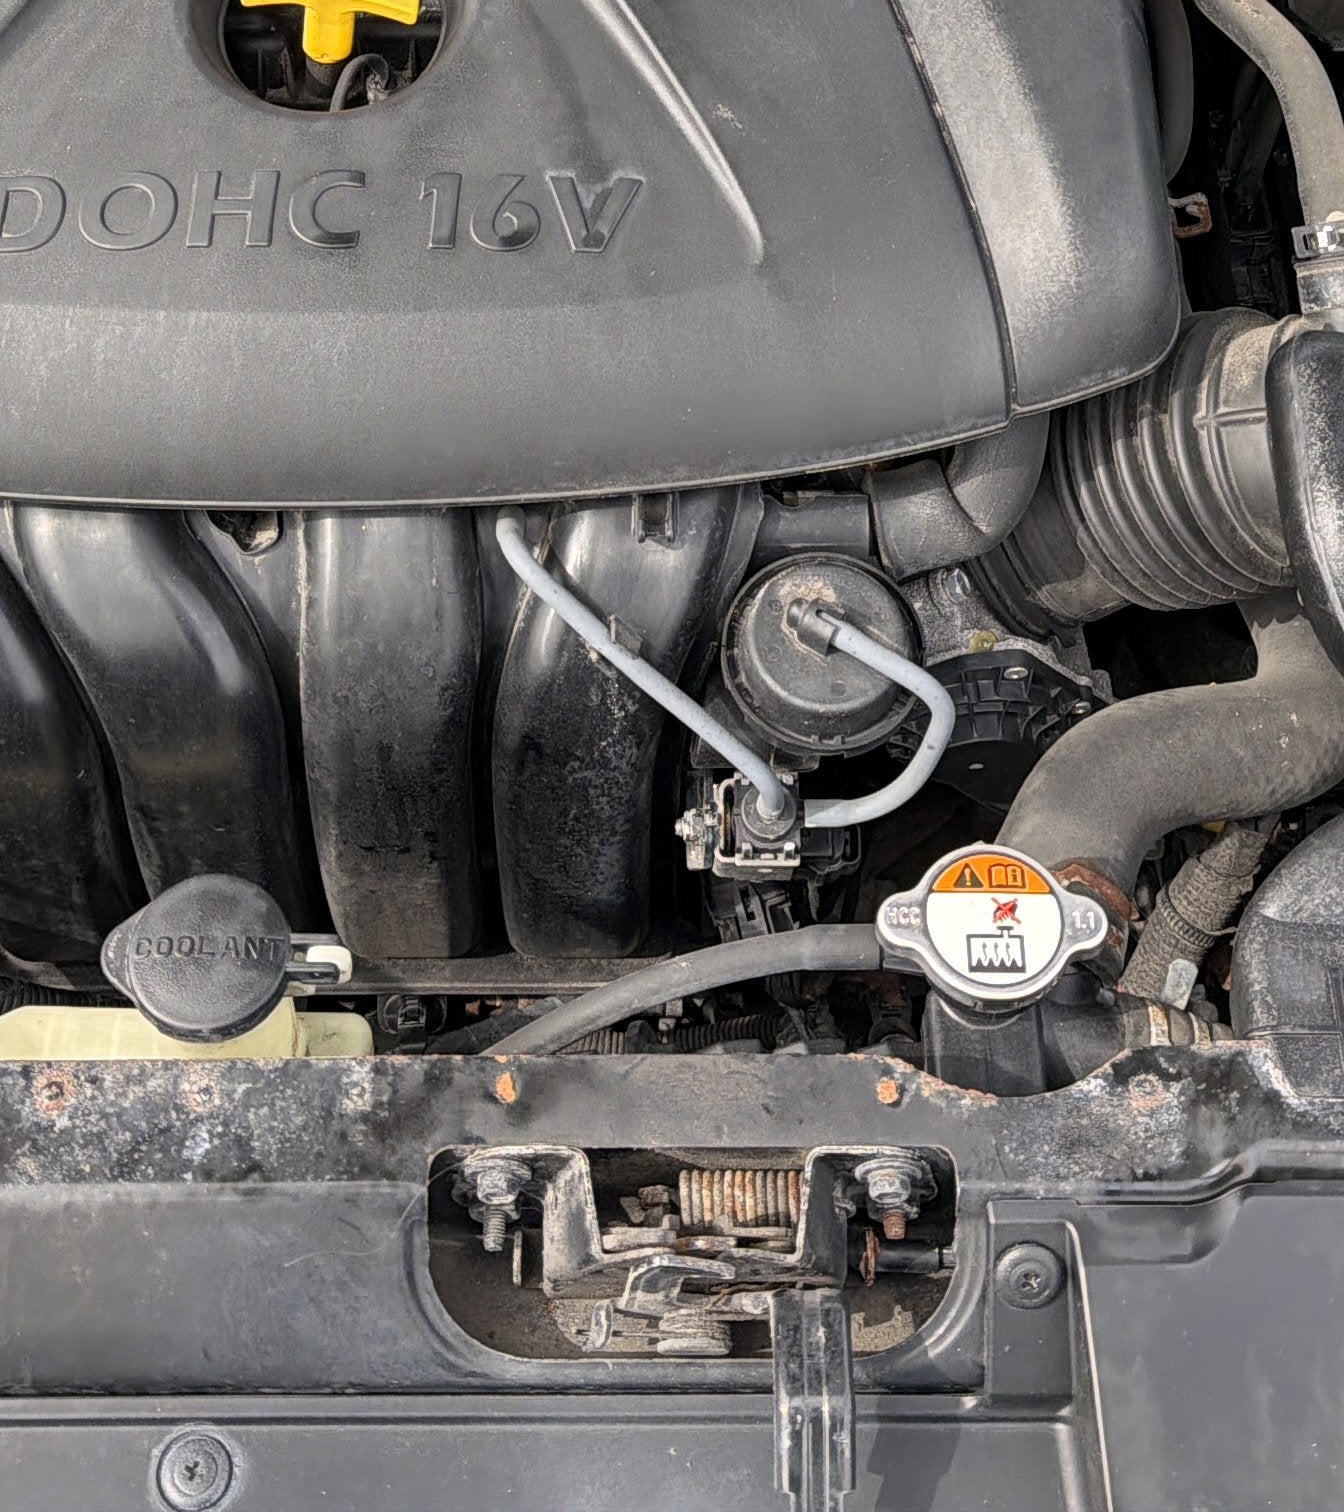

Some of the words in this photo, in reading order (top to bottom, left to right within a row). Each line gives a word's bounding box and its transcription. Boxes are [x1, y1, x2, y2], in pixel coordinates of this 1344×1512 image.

[416, 168, 647, 254] 16V
[1071, 910, 1096, 930] 1.1
[134, 935, 285, 962] COOLANT
